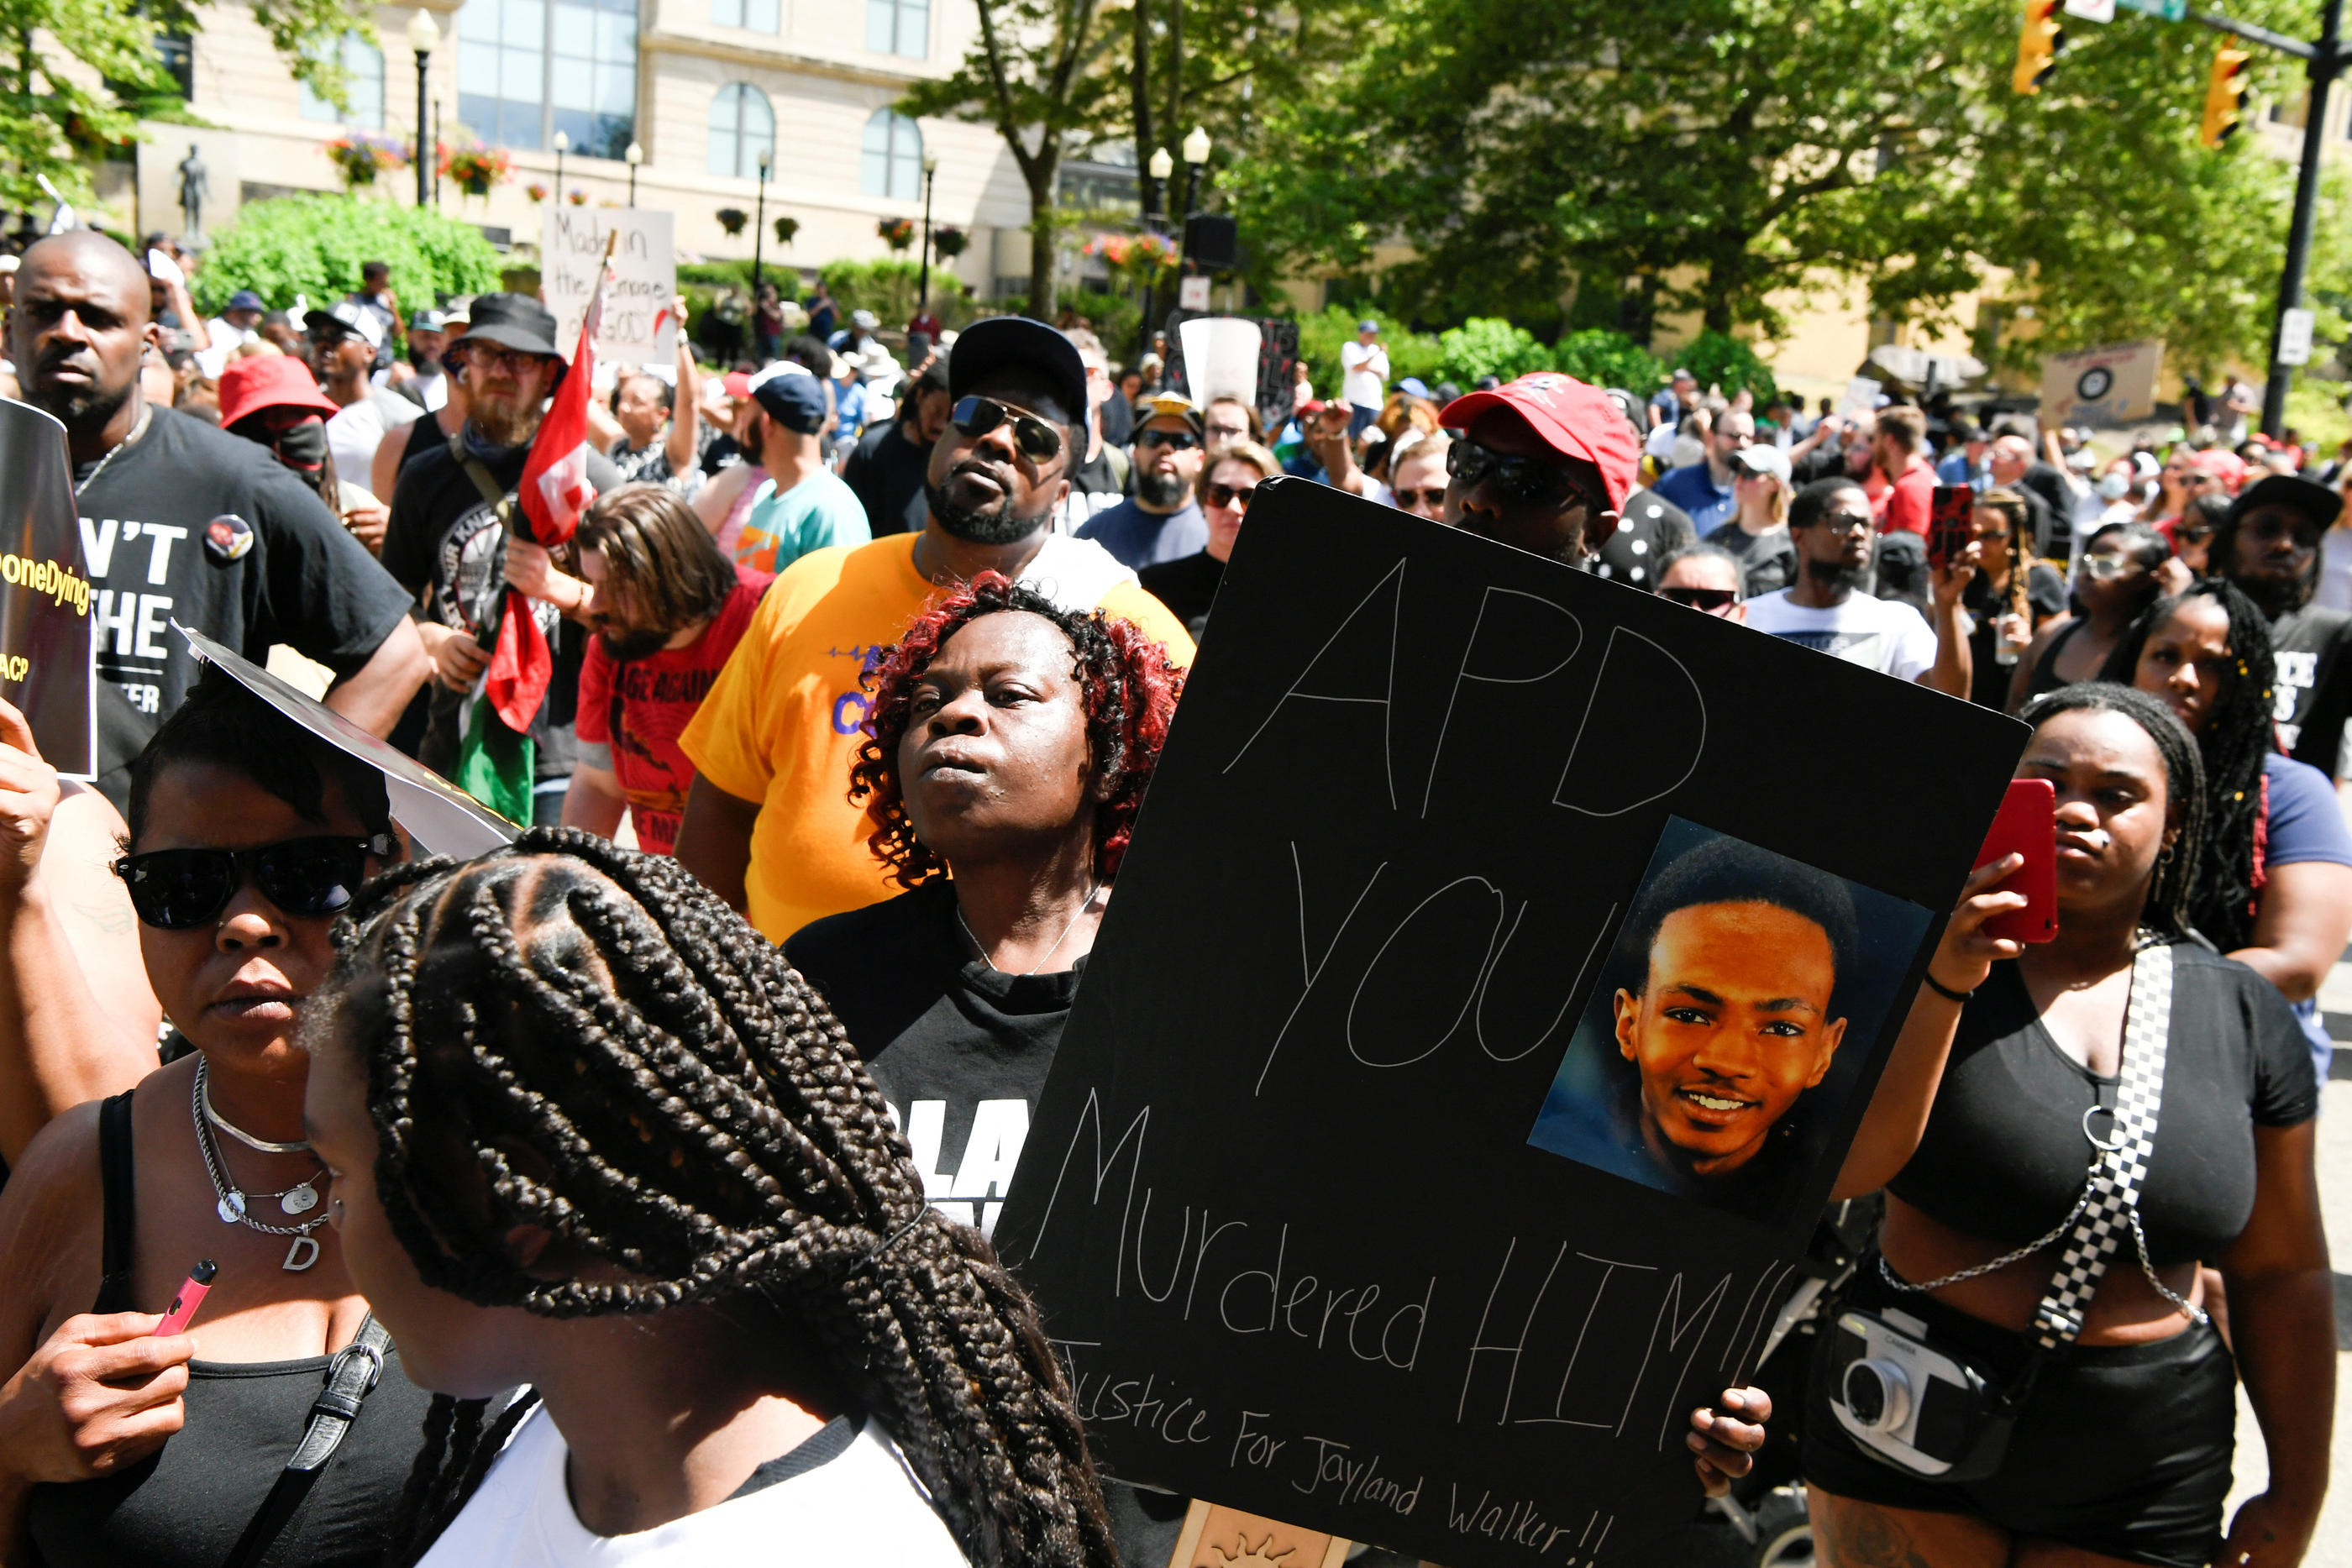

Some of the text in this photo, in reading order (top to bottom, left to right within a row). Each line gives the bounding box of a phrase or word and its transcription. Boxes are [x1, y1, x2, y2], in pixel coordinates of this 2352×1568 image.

[556, 264, 589, 294] the
[622, 228, 648, 260] in
[0, 553, 90, 616] oneDying
[89, 589, 173, 659] HE
[1222, 557, 1707, 820] APD
[1255, 841, 1619, 1096] YOU
[885, 1099, 1030, 1199] LA
[282, 1236, 320, 1271] D
[1030, 1087, 1436, 1372] Murdered
[1884, 1335, 1916, 1356] CAMERA
[1049, 1338, 1614, 1568] Justice For Jayland Walker!!
